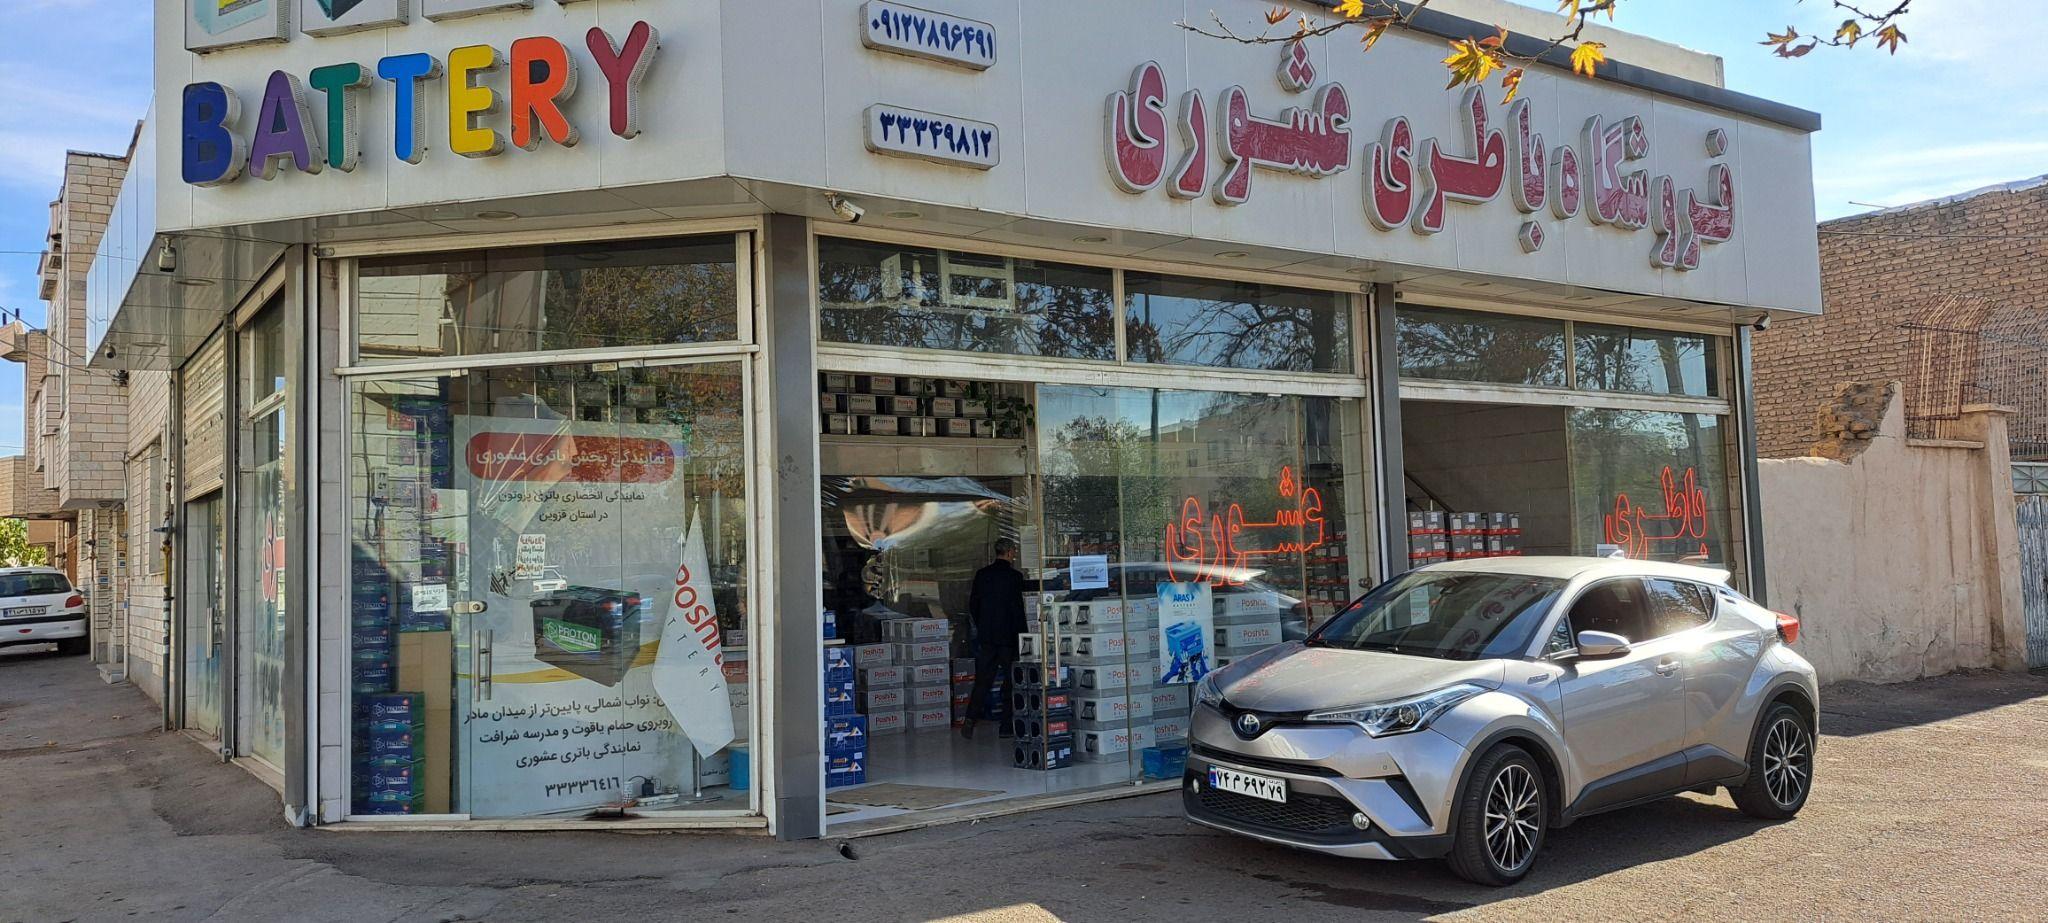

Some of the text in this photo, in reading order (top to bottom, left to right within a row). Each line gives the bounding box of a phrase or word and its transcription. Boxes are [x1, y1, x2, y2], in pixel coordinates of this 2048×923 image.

[871, 8, 993, 59] ۰۹۱۲۷۸۹۶۴۹۱
[181, 20, 656, 186] BATTERY
[880, 112, 992, 158] ۳۳۳۴۹۸۱۲
[1105, 40, 1735, 270] فروشگاه باطری عشوری
[476, 448, 666, 468] نمایندگی پخش باتری عشوری
[561, 490, 604, 503] انحصاری
[605, 490, 645, 503] نمایندگی
[539, 509, 609, 522] در استان قزوین
[1166, 465, 1324, 587] عشوری
[558, 625, 597, 643] PROTON
[528, 703, 538, 719] از
[625, 694, 650, 708] نواب
[463, 709, 489, 725] مادر
[492, 706, 526, 722] میدان
[479, 720, 673, 746] روبروی حمام یاقوت و مدرسه شرافت
[516, 741, 641, 768] نمایندگی باتری عشوری
[1216, 769, 1230, 787] ۷۴
[1233, 774, 1241, 789] م
[1244, 776, 1266, 796] ۶۹۲
[1268, 785, 1284, 801] ۷۹
